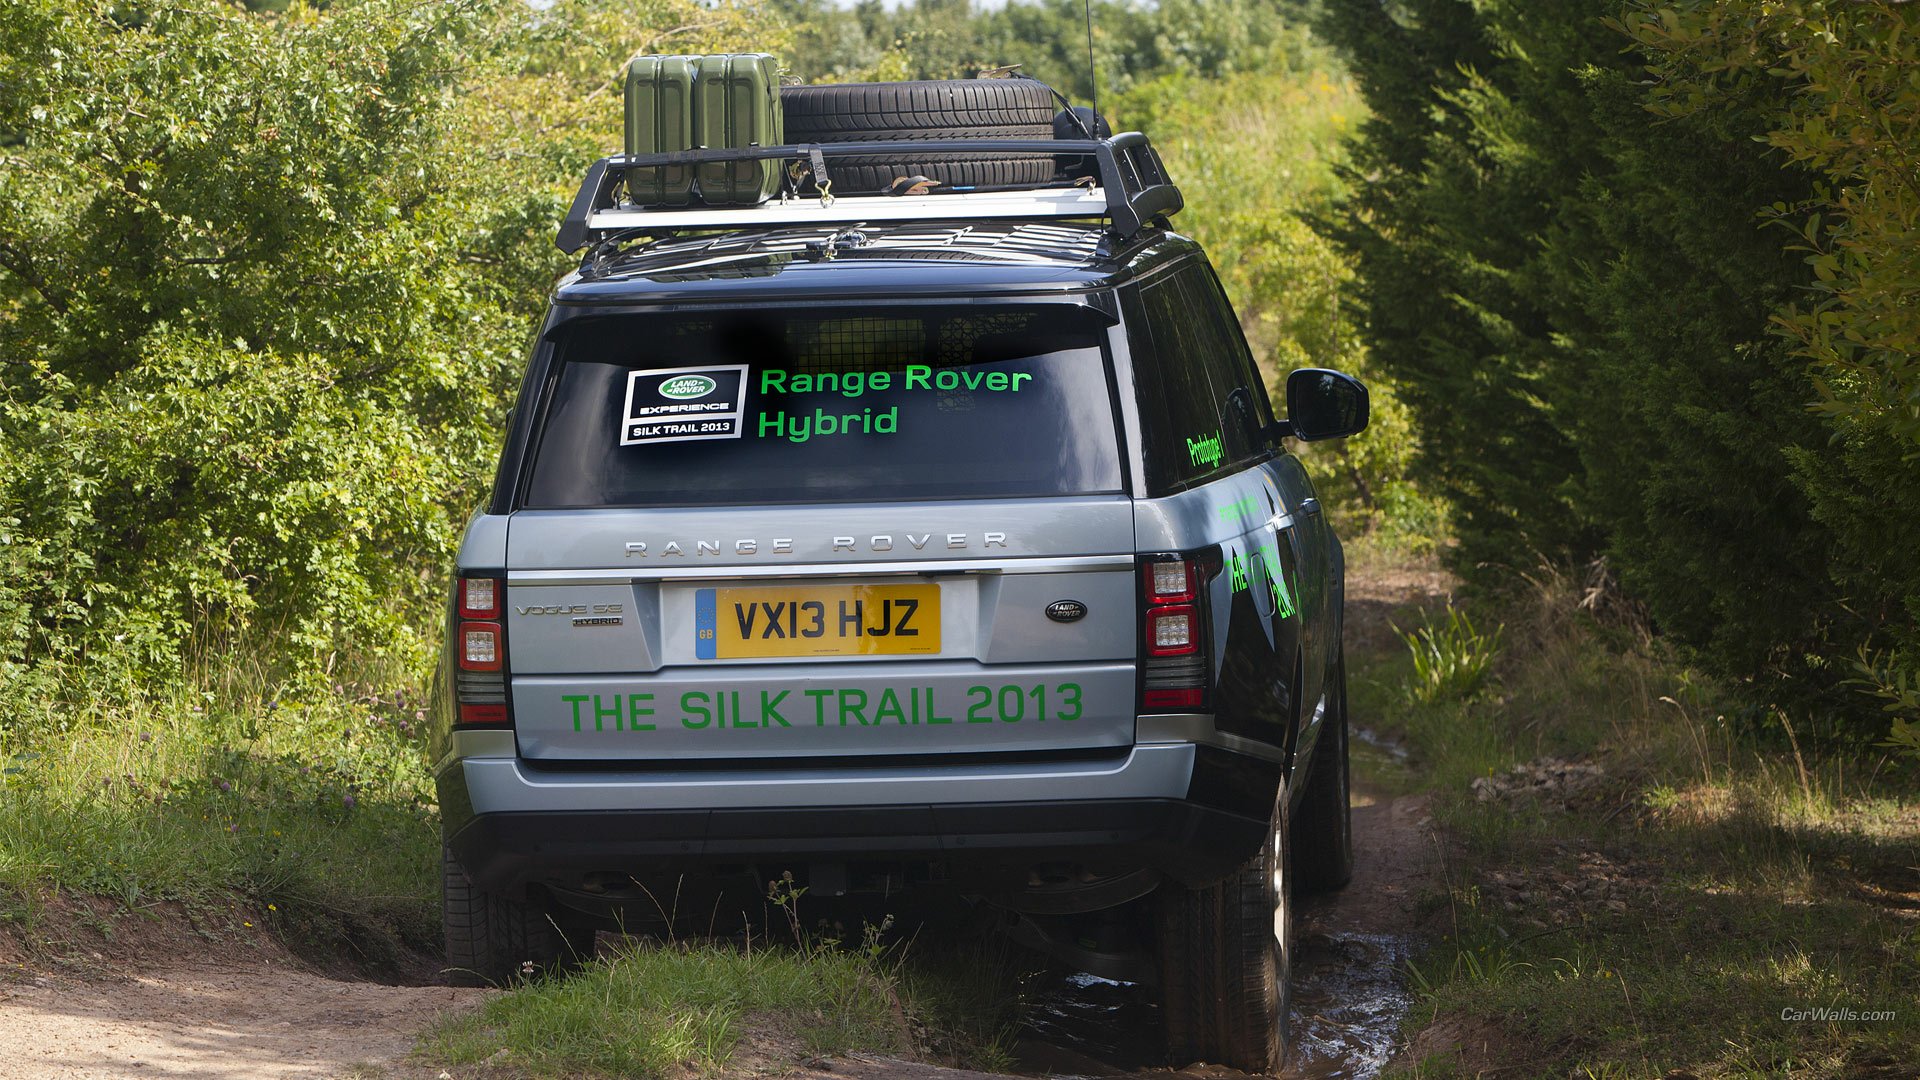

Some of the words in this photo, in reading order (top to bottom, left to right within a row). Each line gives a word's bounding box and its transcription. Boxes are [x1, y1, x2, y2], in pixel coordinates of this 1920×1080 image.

[671, 380, 698, 388] LAND
[761, 369, 891, 398] Range
[905, 365, 1032, 391] Rover
[672, 385, 705, 394] ROVER
[640, 403, 729, 414] EXPERIENCE
[633, 426, 661, 436] SILK
[663, 424, 698, 434] TRAIL
[701, 422, 730, 432] 2013
[758, 406, 898, 443] Hybrid
[625, 538, 793, 557] RANGE
[832, 532, 1007, 552] ROVER
[515, 604, 588, 615] VOGUE
[593, 604, 623, 614] SE
[734, 601, 825, 640] VX13
[839, 599, 919, 637] HJZ
[699, 629, 713, 640] GB
[562, 694, 657, 732] THE
[680, 690, 792, 730] SILK
[804, 687, 953, 727] TRAIL
[967, 683, 1084, 722] 2013
